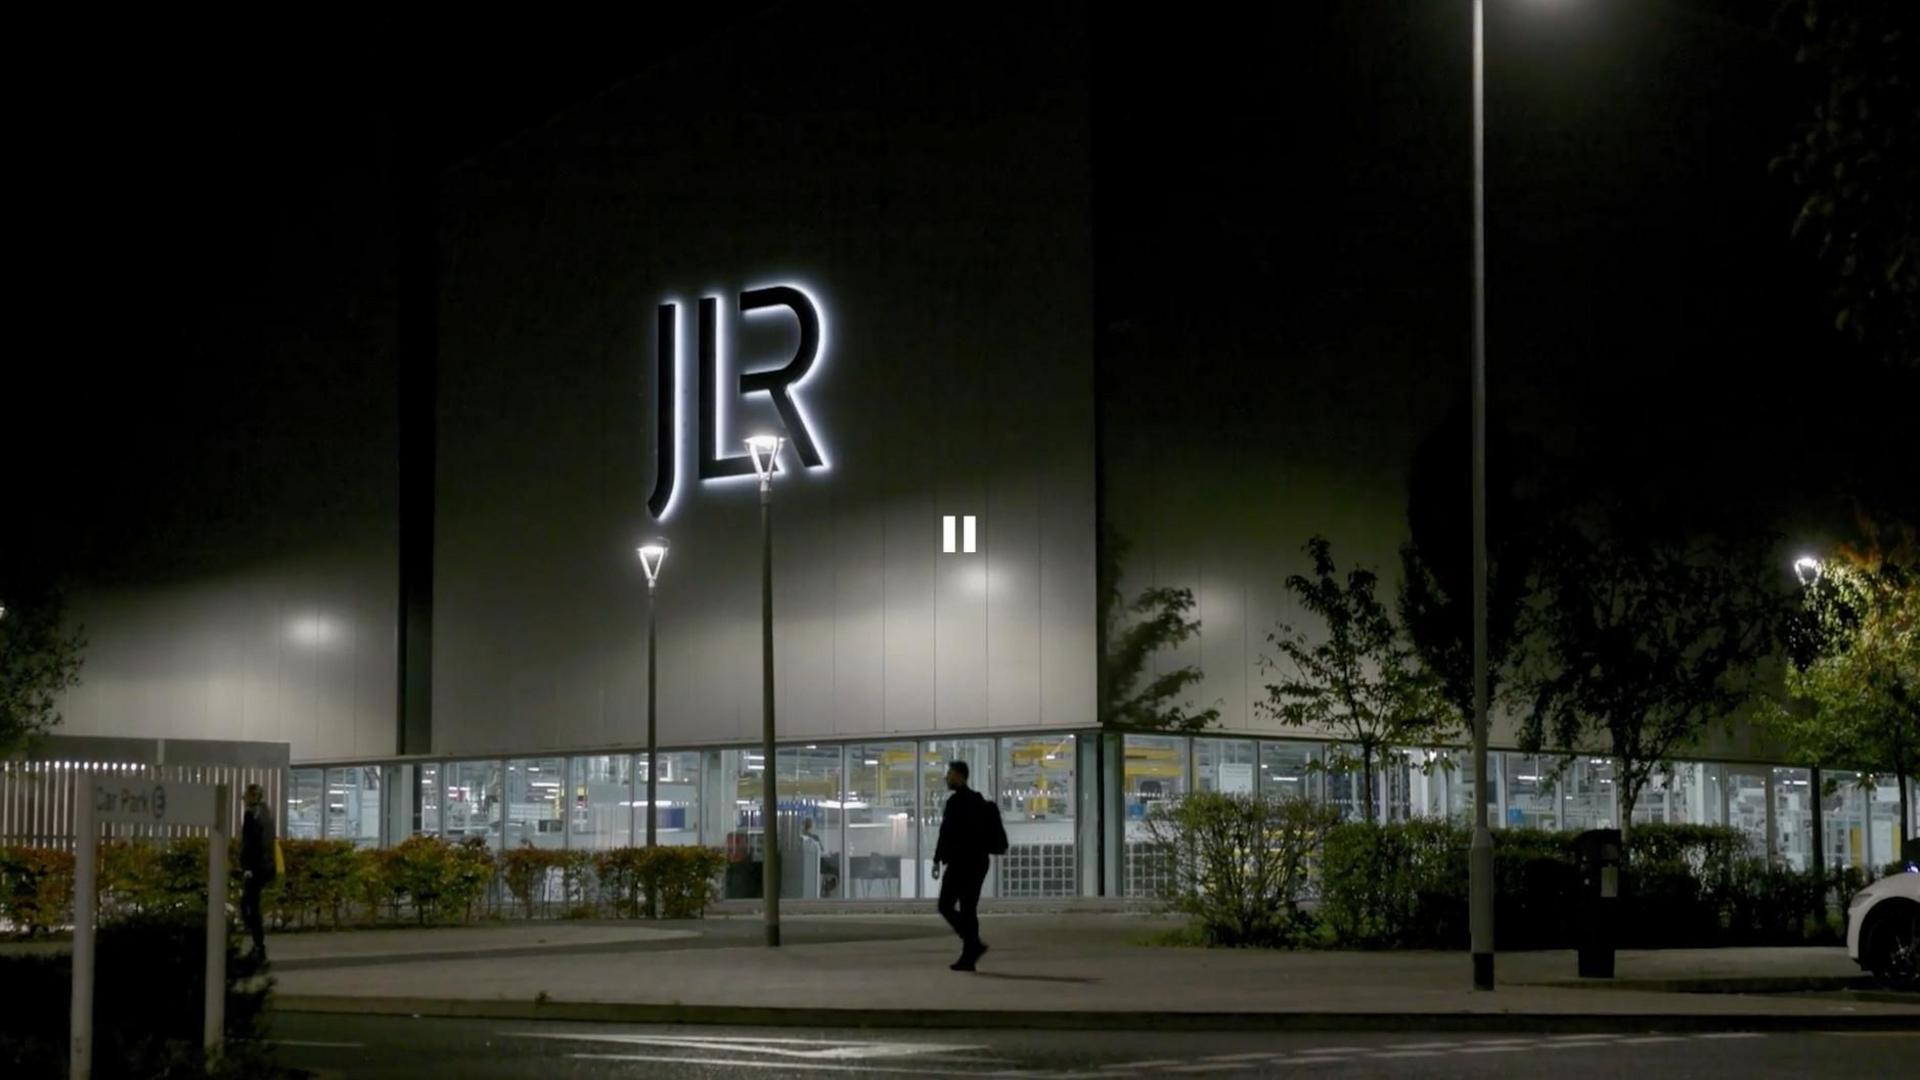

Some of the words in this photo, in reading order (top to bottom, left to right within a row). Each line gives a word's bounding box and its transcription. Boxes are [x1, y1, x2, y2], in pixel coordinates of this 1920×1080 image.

[647, 284, 825, 519] JLR
[96, 786, 117, 811] Car
[121, 788, 148, 813] Park
